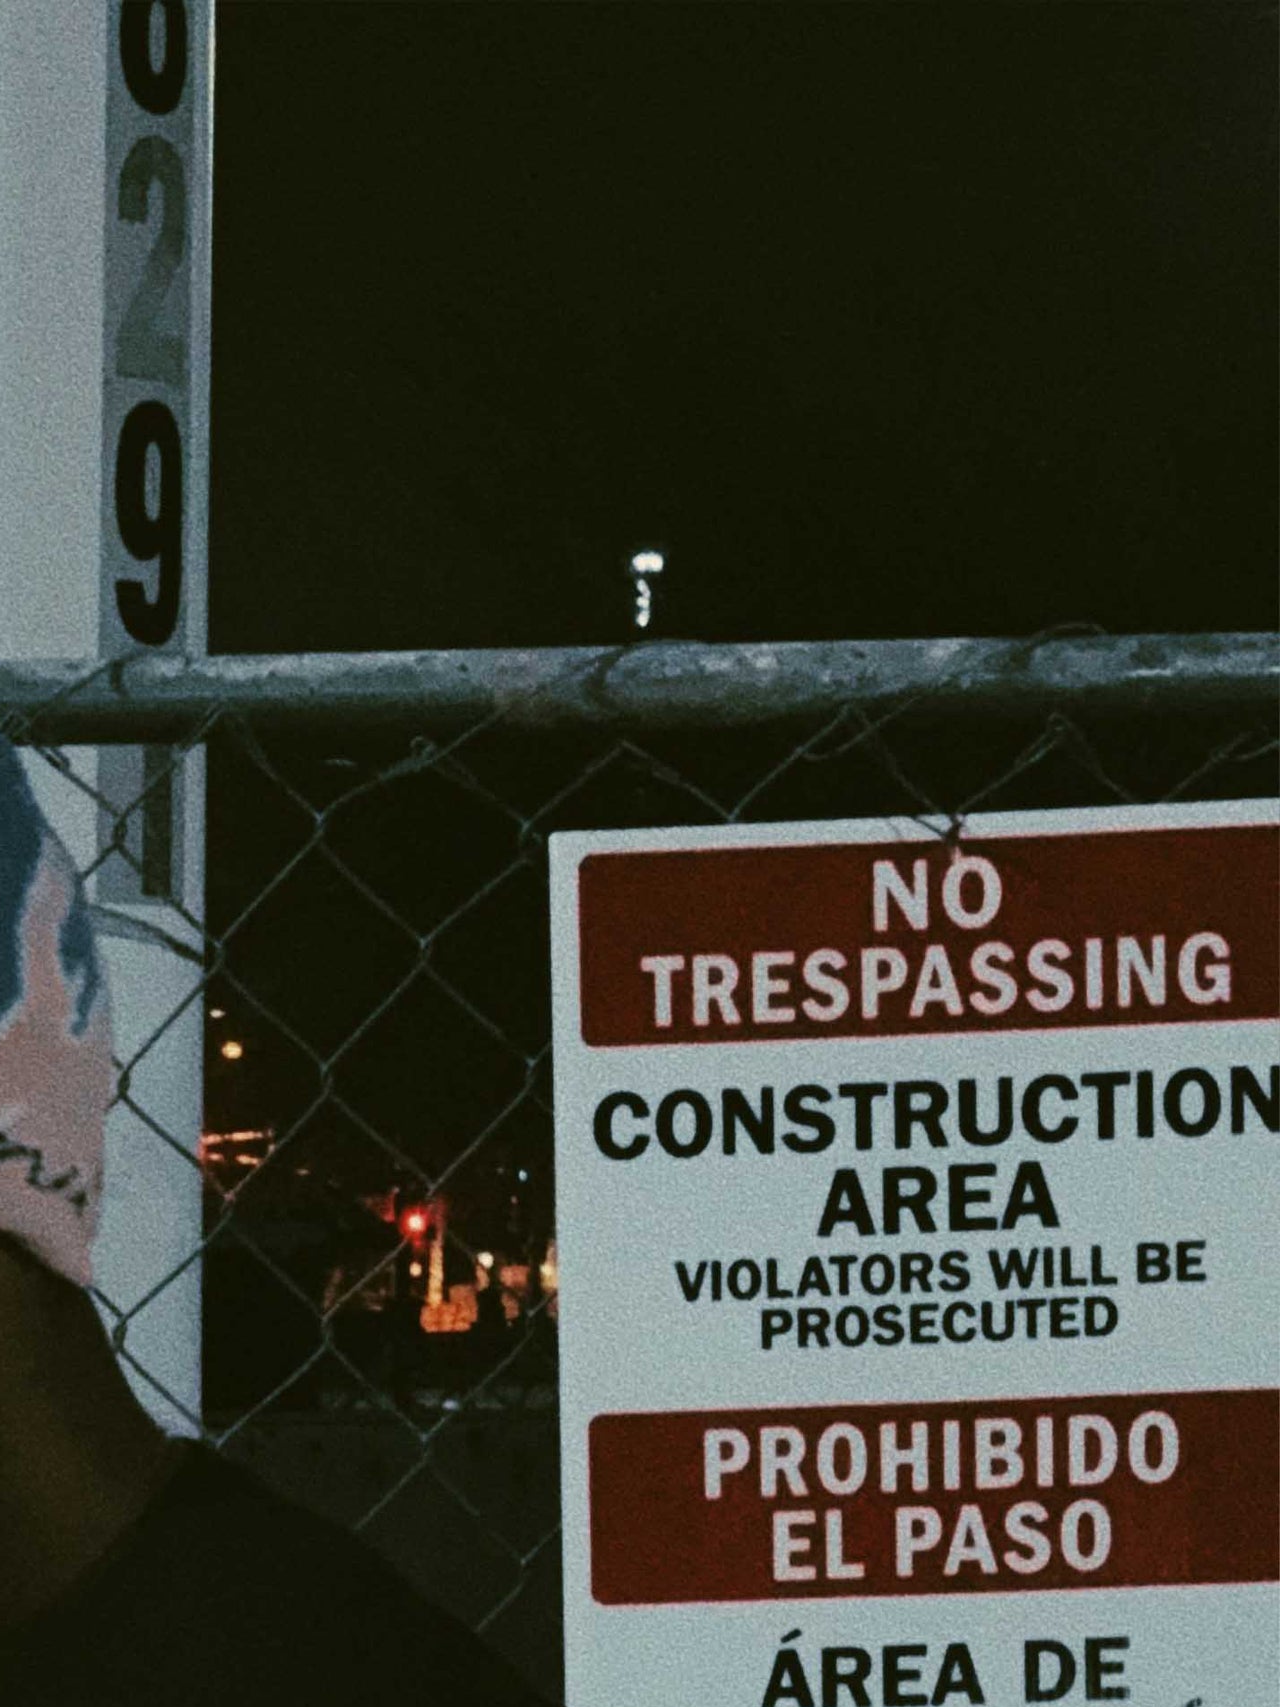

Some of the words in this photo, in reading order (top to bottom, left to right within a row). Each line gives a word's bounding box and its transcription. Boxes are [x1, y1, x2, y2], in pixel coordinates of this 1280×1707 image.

[871, 847, 1004, 933] NO
[640, 931, 1234, 1028] TRESPASSING
[592, 1064, 1280, 1161] CONSTRUCTION
[817, 1160, 1060, 1238] AREA
[674, 1250, 971, 1303] VIOLATORS
[988, 1245, 1118, 1291] WILL
[1136, 1240, 1207, 1284] BE
[760, 1295, 1120, 1350] PROSECUTED
[702, 1409, 1180, 1500] PROHIBIDO
[772, 1508, 865, 1582] EL
[895, 1498, 1112, 1578] PASO
[1024, 1636, 1130, 1703] DE
